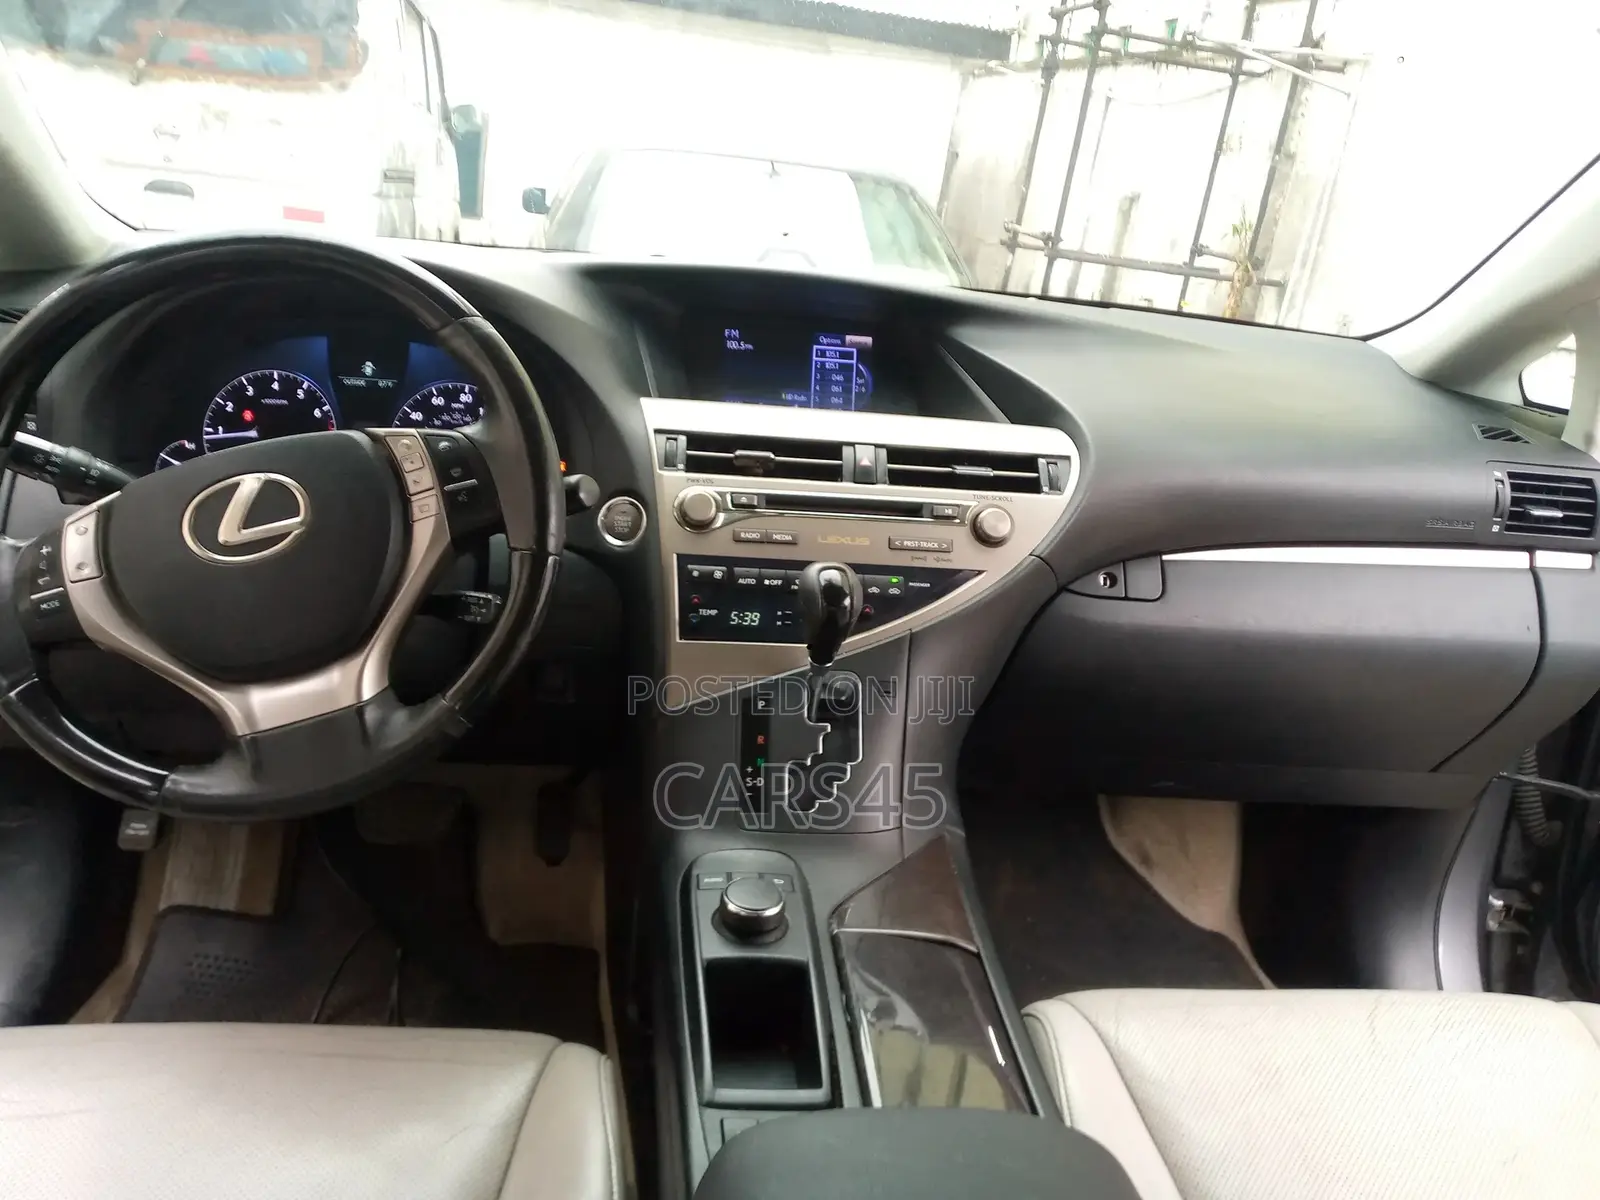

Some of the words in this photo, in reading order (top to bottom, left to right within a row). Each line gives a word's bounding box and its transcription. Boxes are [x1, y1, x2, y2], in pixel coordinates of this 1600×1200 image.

[245, 385, 255, 396] 3
[271, 380, 280, 391] 4
[296, 388, 305, 400] 5
[459, 393, 473, 403] 80
[225, 401, 234, 412] 2
[431, 396, 445, 406] 60
[313, 407, 322, 419] 6
[409, 411, 424, 422] 40
[740, 531, 761, 540] RADIO
[772, 533, 793, 541] MEDIA
[817, 534, 871, 546] LEXUS
[698, 608, 719, 616] TEMP
[729, 611, 761, 626] 5:39
[757, 700, 766, 709] P
[757, 735, 765, 745] R
